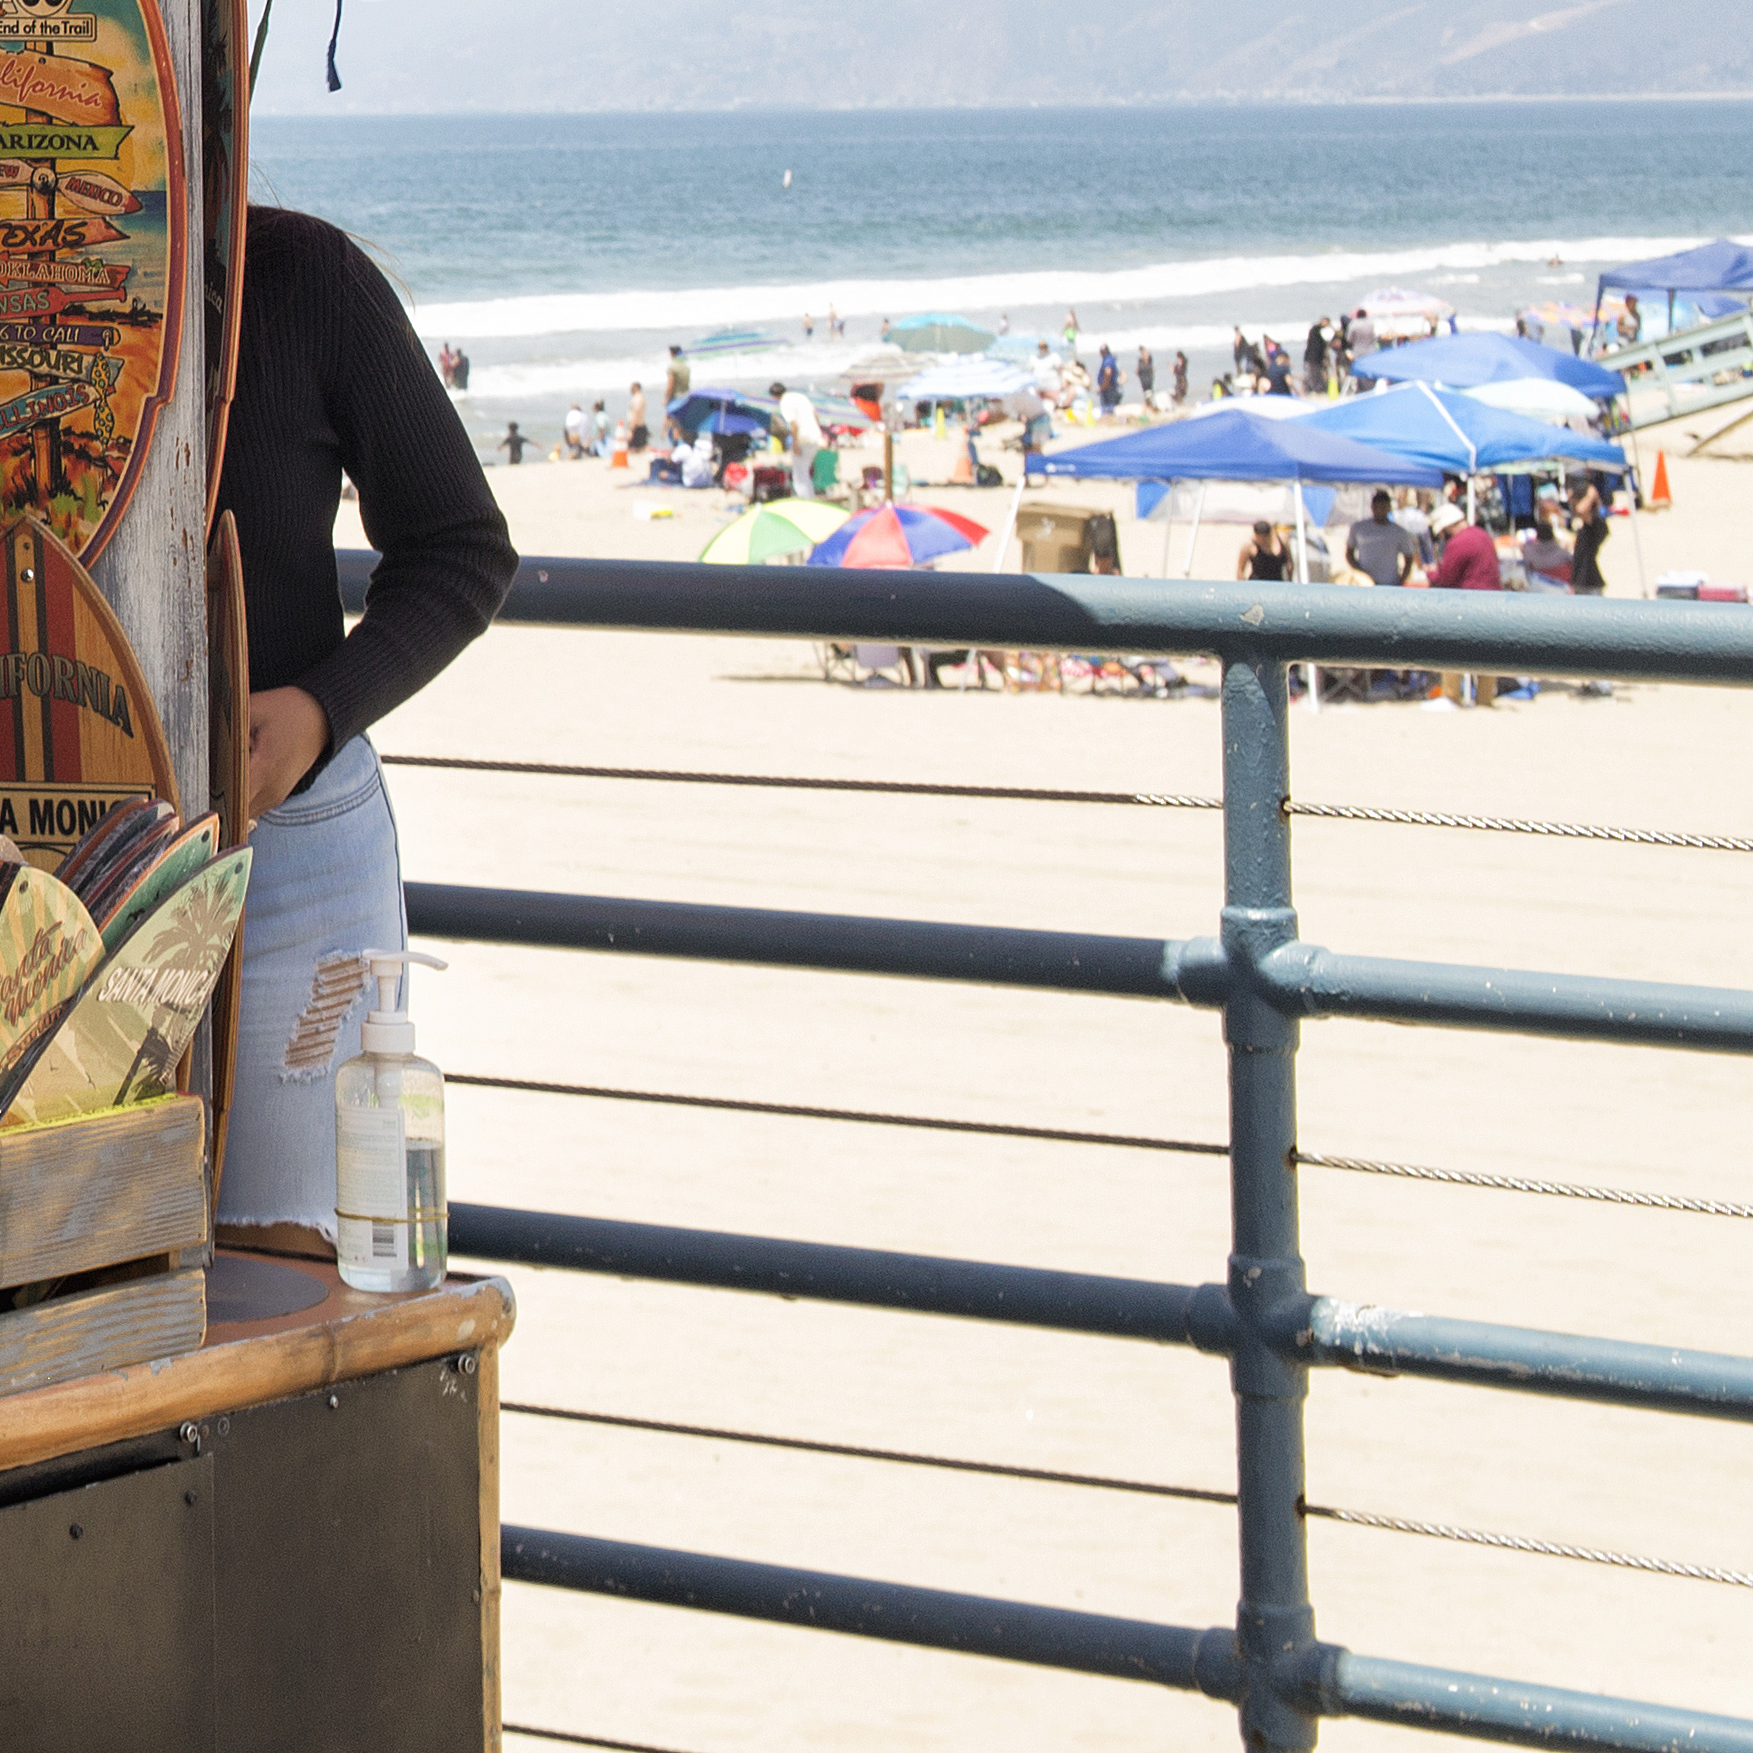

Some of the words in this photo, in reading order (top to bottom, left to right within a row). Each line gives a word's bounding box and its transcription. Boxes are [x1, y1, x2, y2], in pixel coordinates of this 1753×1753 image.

[39, 18, 61, 35] the
[61, 18, 90, 36] Trail
[41, 326, 80, 344] CALI
